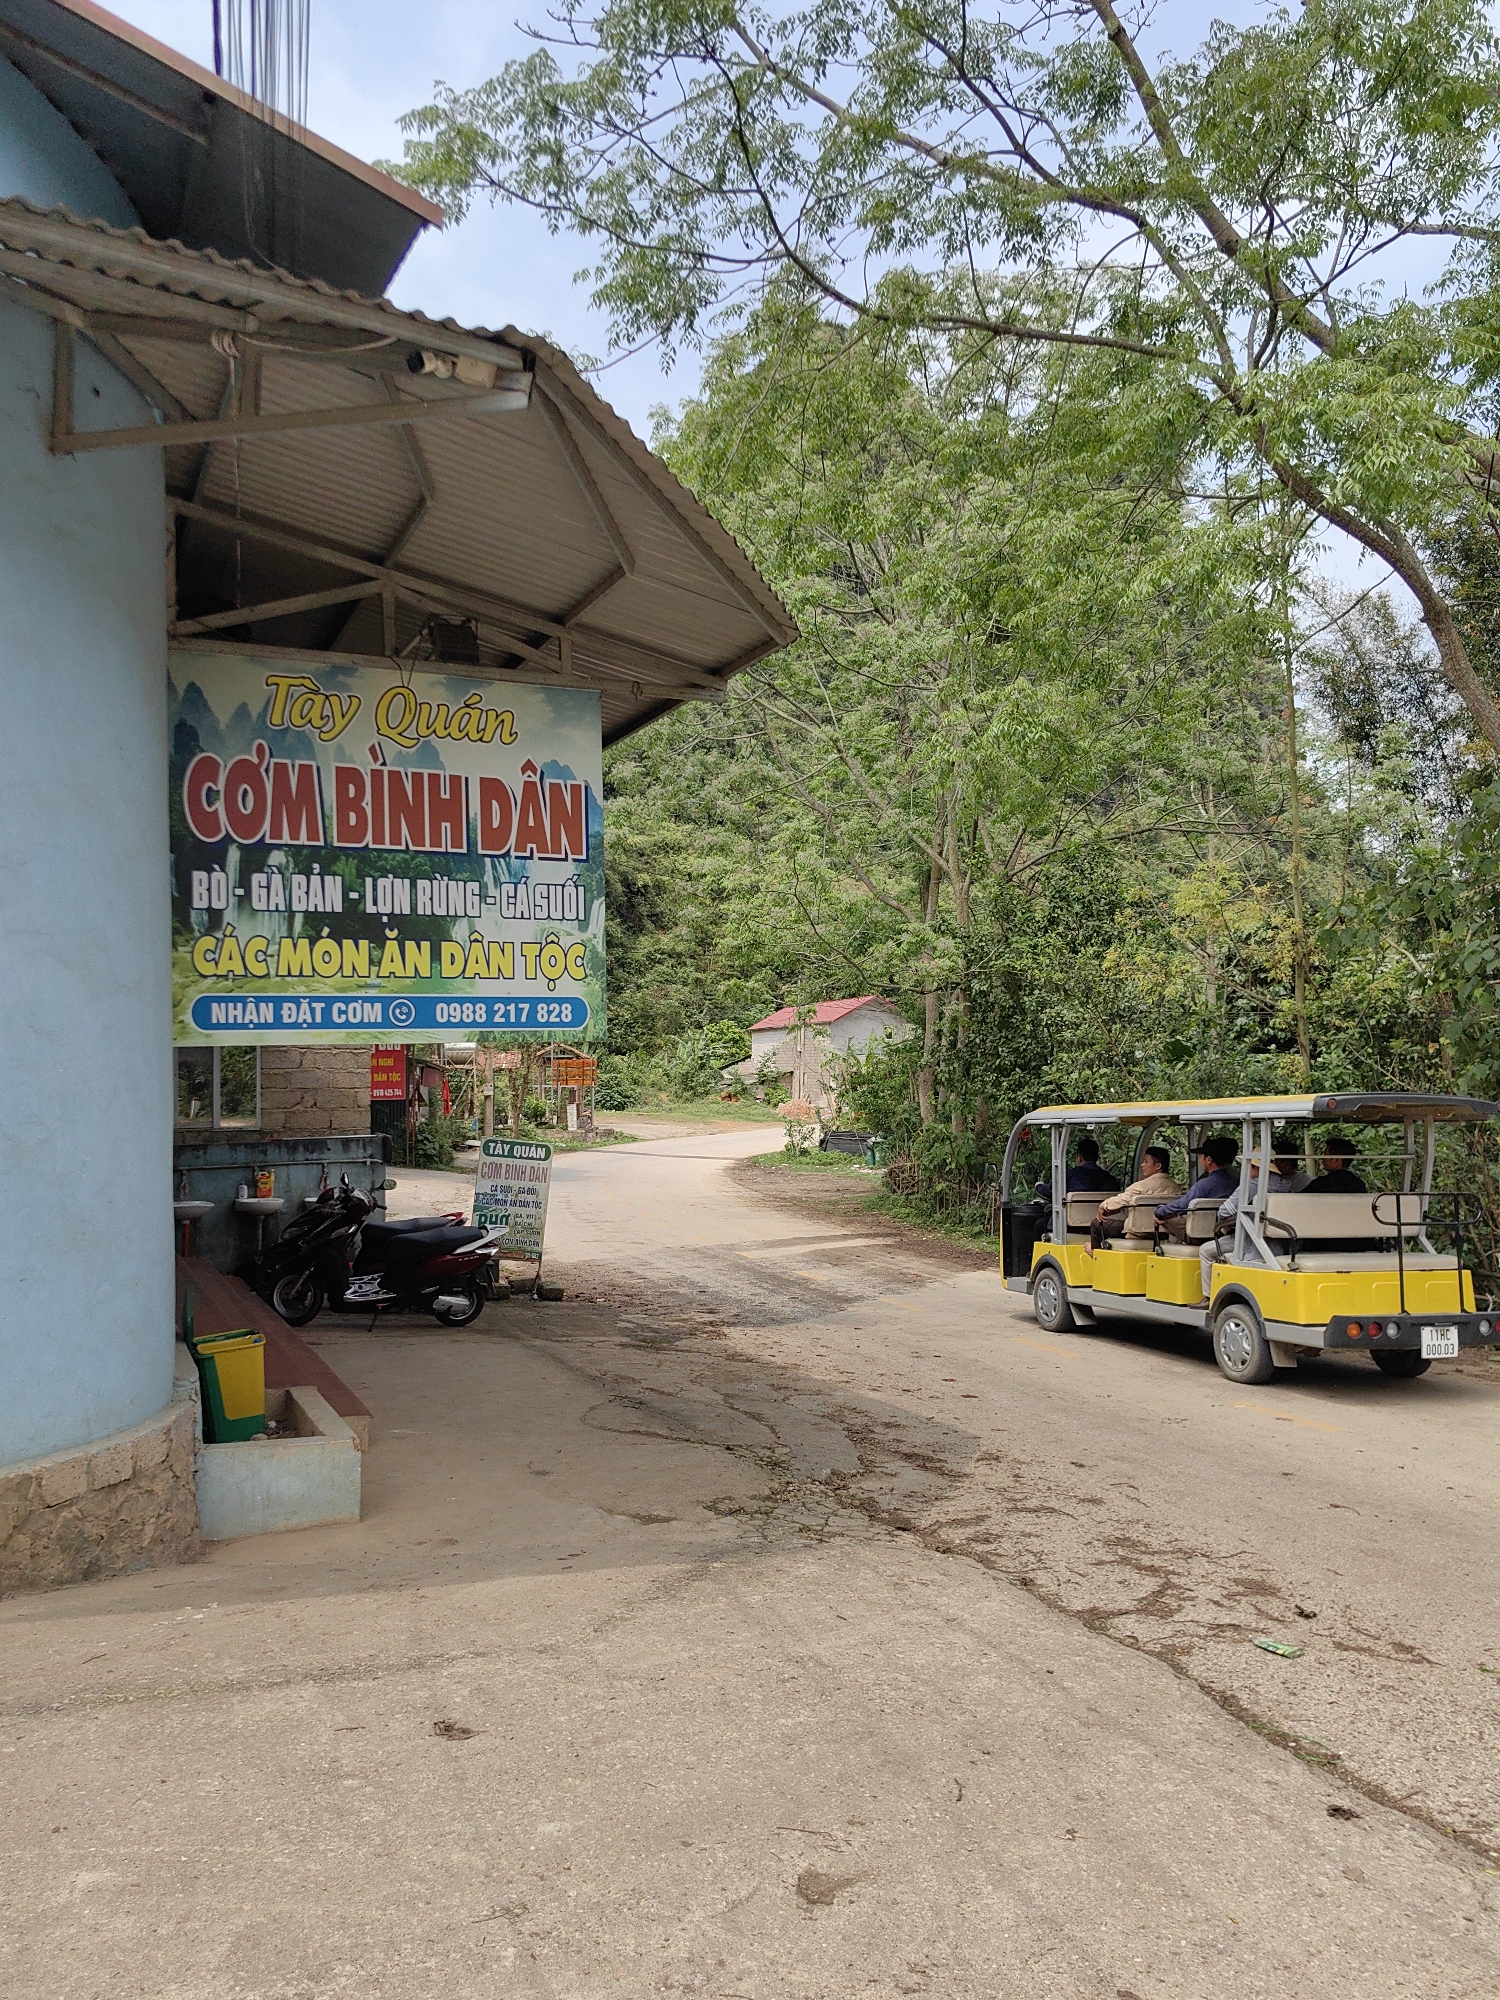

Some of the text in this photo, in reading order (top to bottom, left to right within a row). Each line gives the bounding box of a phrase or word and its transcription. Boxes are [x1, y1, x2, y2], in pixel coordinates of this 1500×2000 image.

[265, 674, 518, 748] Tày Quán
[184, 739, 587, 859] CƠM BÌNH DÂN
[192, 863, 228, 909] BÒ
[251, 865, 287, 911] GÀ
[291, 862, 343, 912] BẢN
[365, 874, 411, 922] LỢN
[416, 872, 481, 917] RỪNG
[501, 876, 531, 919] CÁ
[534, 874, 586, 921] SUỐI
[192, 922, 586, 991] CÁC MÓN ĂN DÂN TỘC
[211, 997, 573, 1028] NHẬN ĐẶT CƠM 0988 217 828
[488, 1141, 546, 1158] TÀY QUÁN
[481, 1161, 502, 1179] CƠM
[504, 1160, 527, 1182] BÌNH
[478, 1208, 511, 1226] PHỞ
[1430, 1329, 1451, 1341] 11HC
[1426, 1343, 1455, 1356] 000.03
